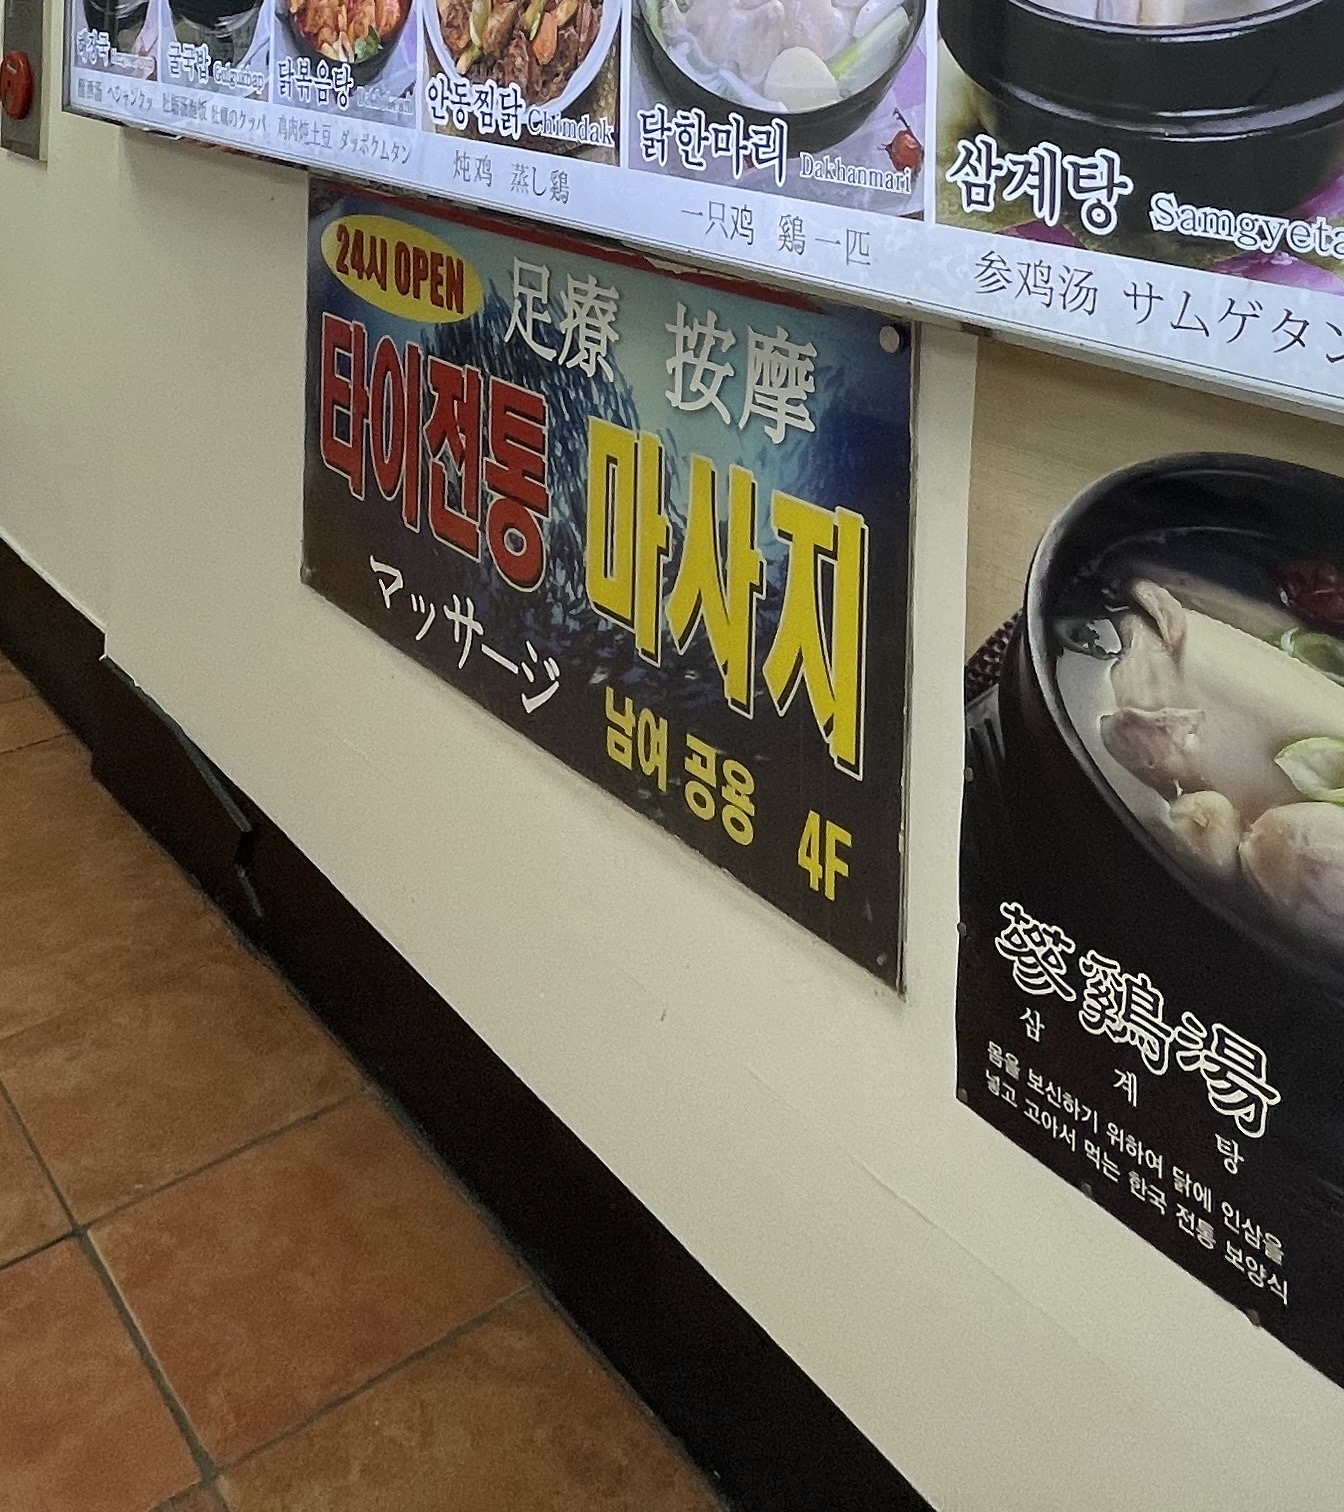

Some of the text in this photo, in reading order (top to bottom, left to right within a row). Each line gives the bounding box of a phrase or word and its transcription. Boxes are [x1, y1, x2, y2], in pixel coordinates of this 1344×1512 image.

[278, 56, 354, 110] 닭볶음탕
[425, 73, 526, 140] 안동찜닭
[527, 107, 616, 148] Chimdak
[637, 103, 789, 188] 닭한마리
[800, 151, 912, 194] Dakhanmari
[947, 133, 1133, 236] 삼계탕
[335, 222, 466, 315] 24시 OPEN
[681, 200, 755, 246] 一只鸡
[973, 249, 1099, 317] 参鸡汤
[664, 302, 817, 445] 按摩
[321, 311, 552, 594] 타이전통
[370, 554, 561, 714] マッサージ
[587, 416, 870, 782] 마사지
[605, 686, 852, 901] 남여 공용 4F
[1019, 1006, 1245, 1175] 삼 계 탕
[987, 1040, 1285, 1267] 몸을 보신하기 위하여 닭에 인삼을
[1023, 1098, 1077, 1153] 고아서
[1084, 1138, 1122, 1184] 먹는
[1128, 1170, 1168, 1216] 한국
[1175, 1203, 1217, 1250] 전통
[1224, 1240, 1289, 1307] 보양식
